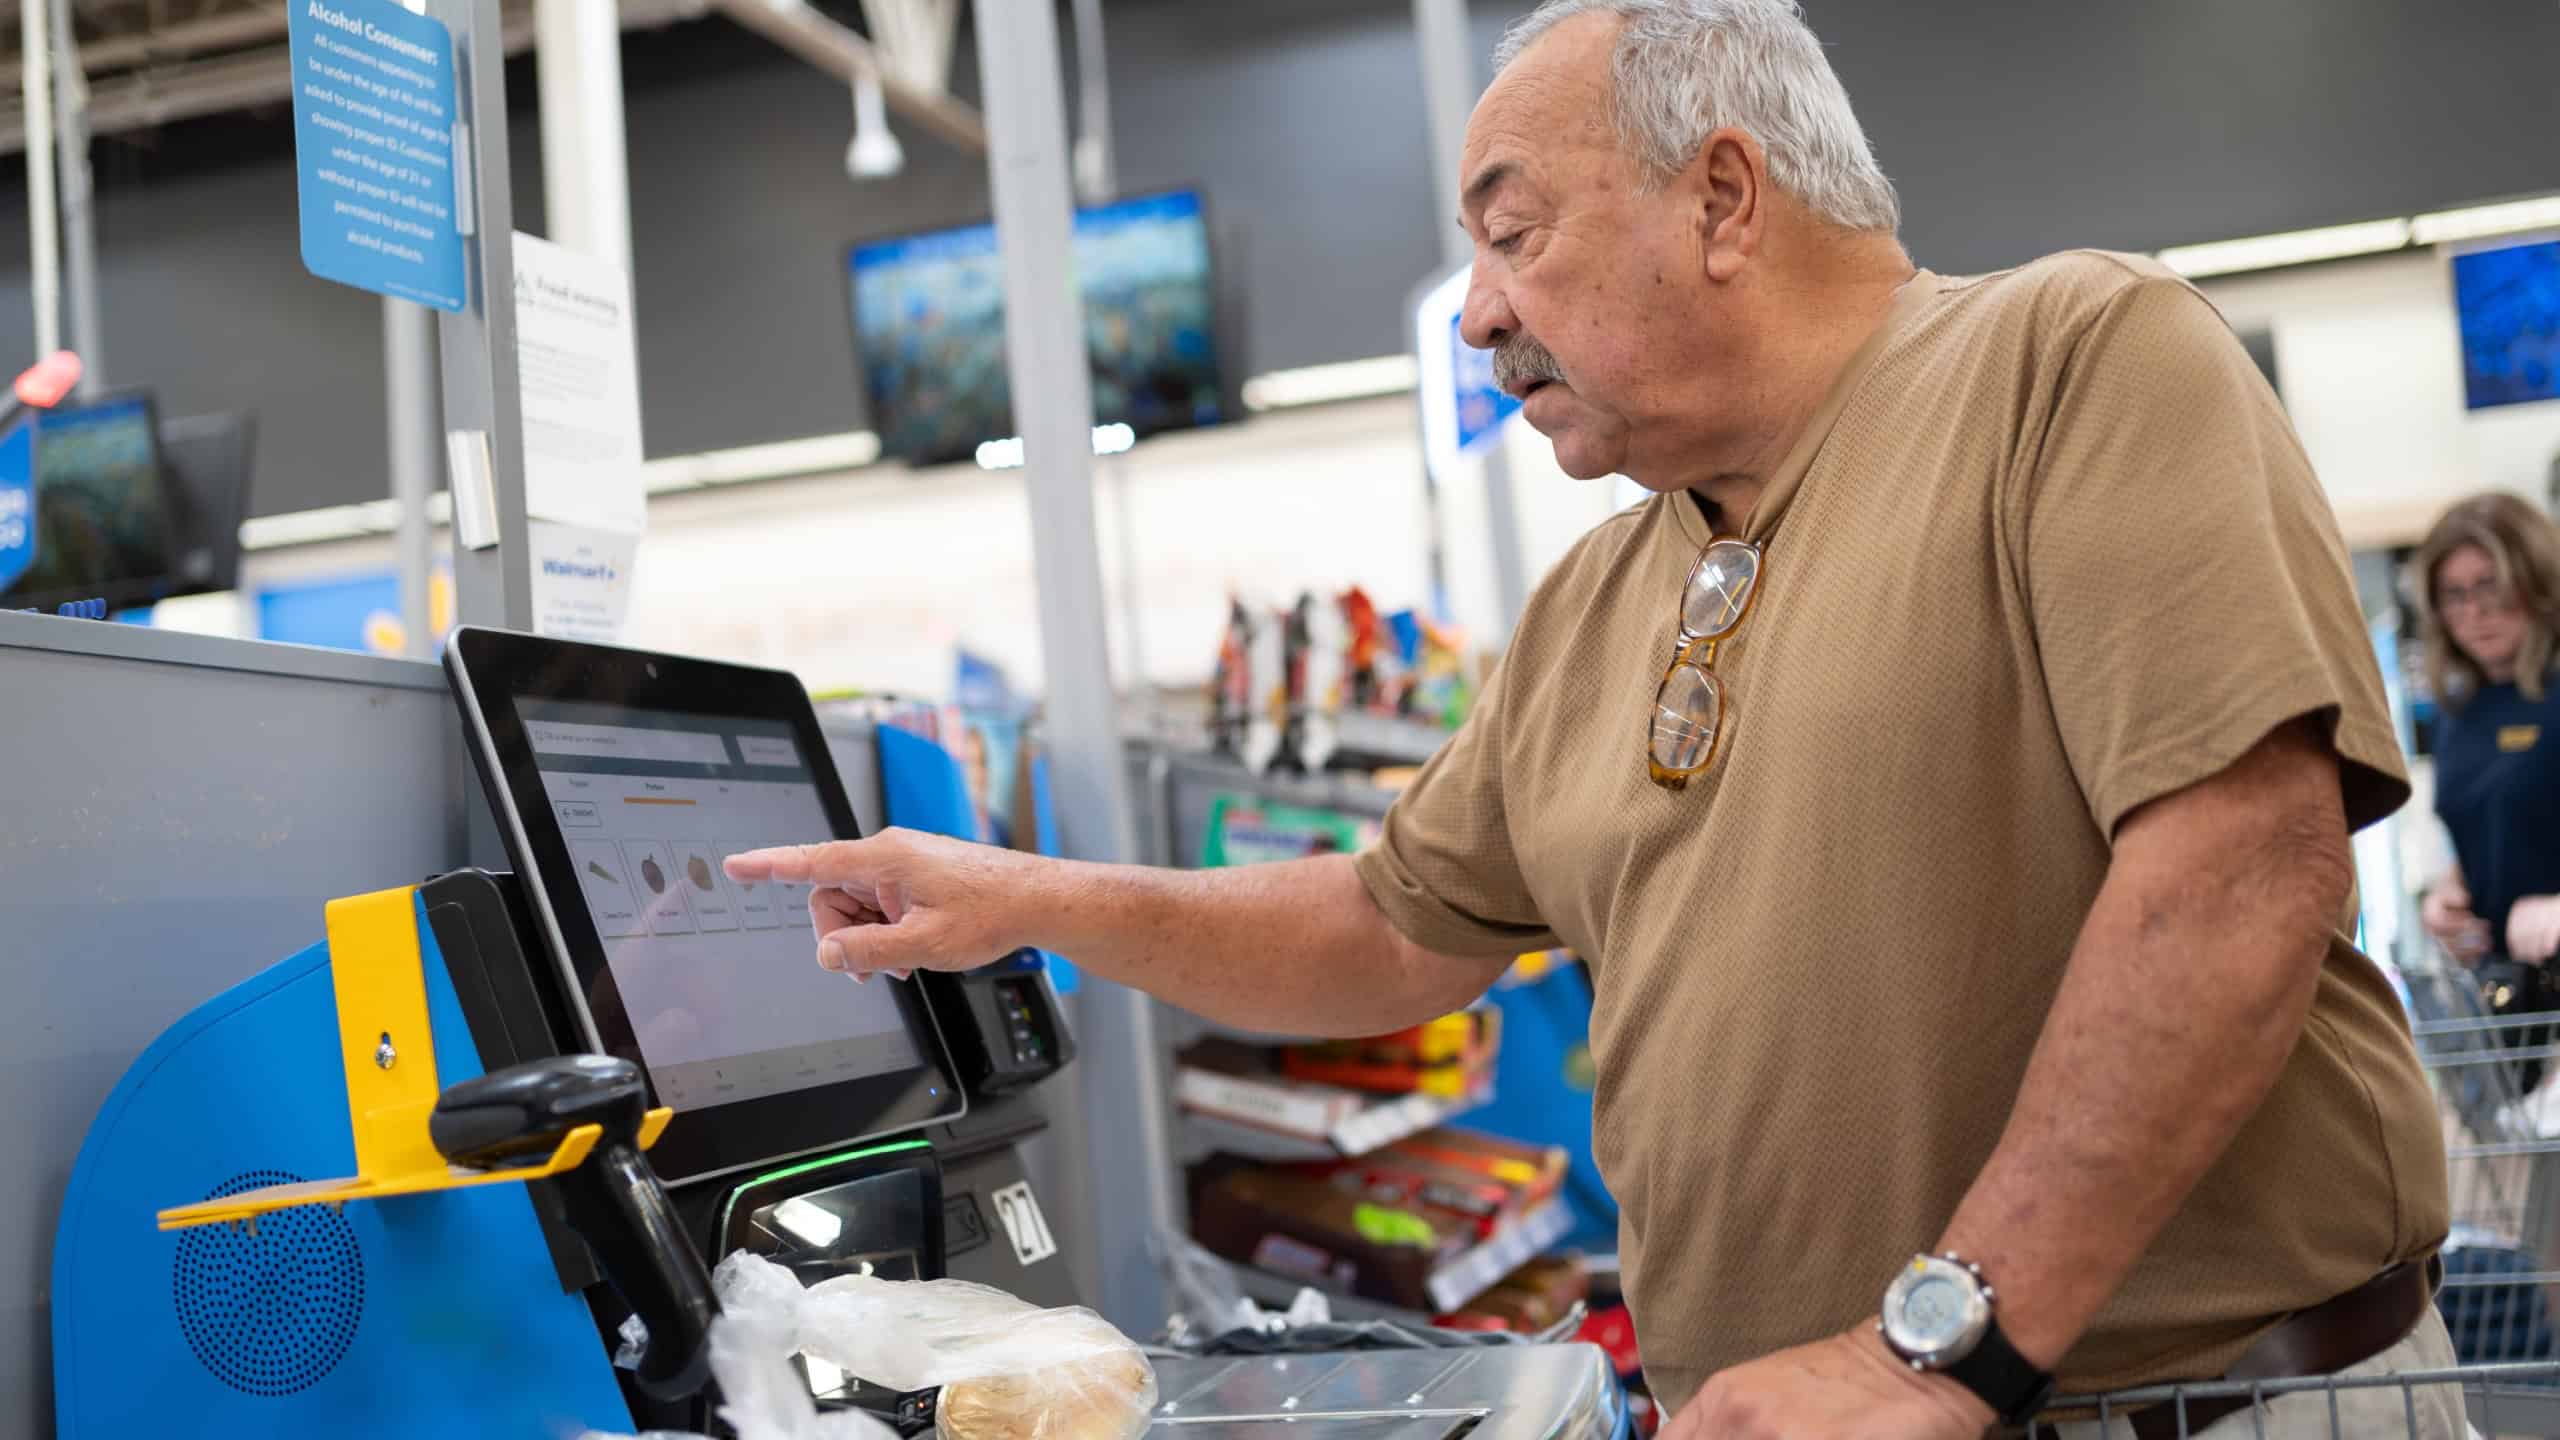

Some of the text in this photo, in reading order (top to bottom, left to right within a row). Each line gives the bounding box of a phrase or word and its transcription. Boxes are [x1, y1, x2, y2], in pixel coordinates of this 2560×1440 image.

[308, 1, 362, 36] Alcohol
[308, 56, 322, 73] be
[323, 64, 352, 83] under
[353, 74, 370, 90] the
[371, 82, 388, 99] age
[390, 88, 400, 100] of
[304, 84, 333, 103] asked
[334, 91, 346, 108] to
[347, 99, 382, 120] provide
[311, 111, 352, 137] showing
[354, 126, 386, 147] proper
[332, 147, 360, 163] under
[361, 155, 379, 170] the
[379, 161, 396, 179] age
[318, 167, 355, 189] without
[357, 180, 388, 198] proper
[334, 199, 381, 224] permitted
[347, 230, 380, 248] alcohol
